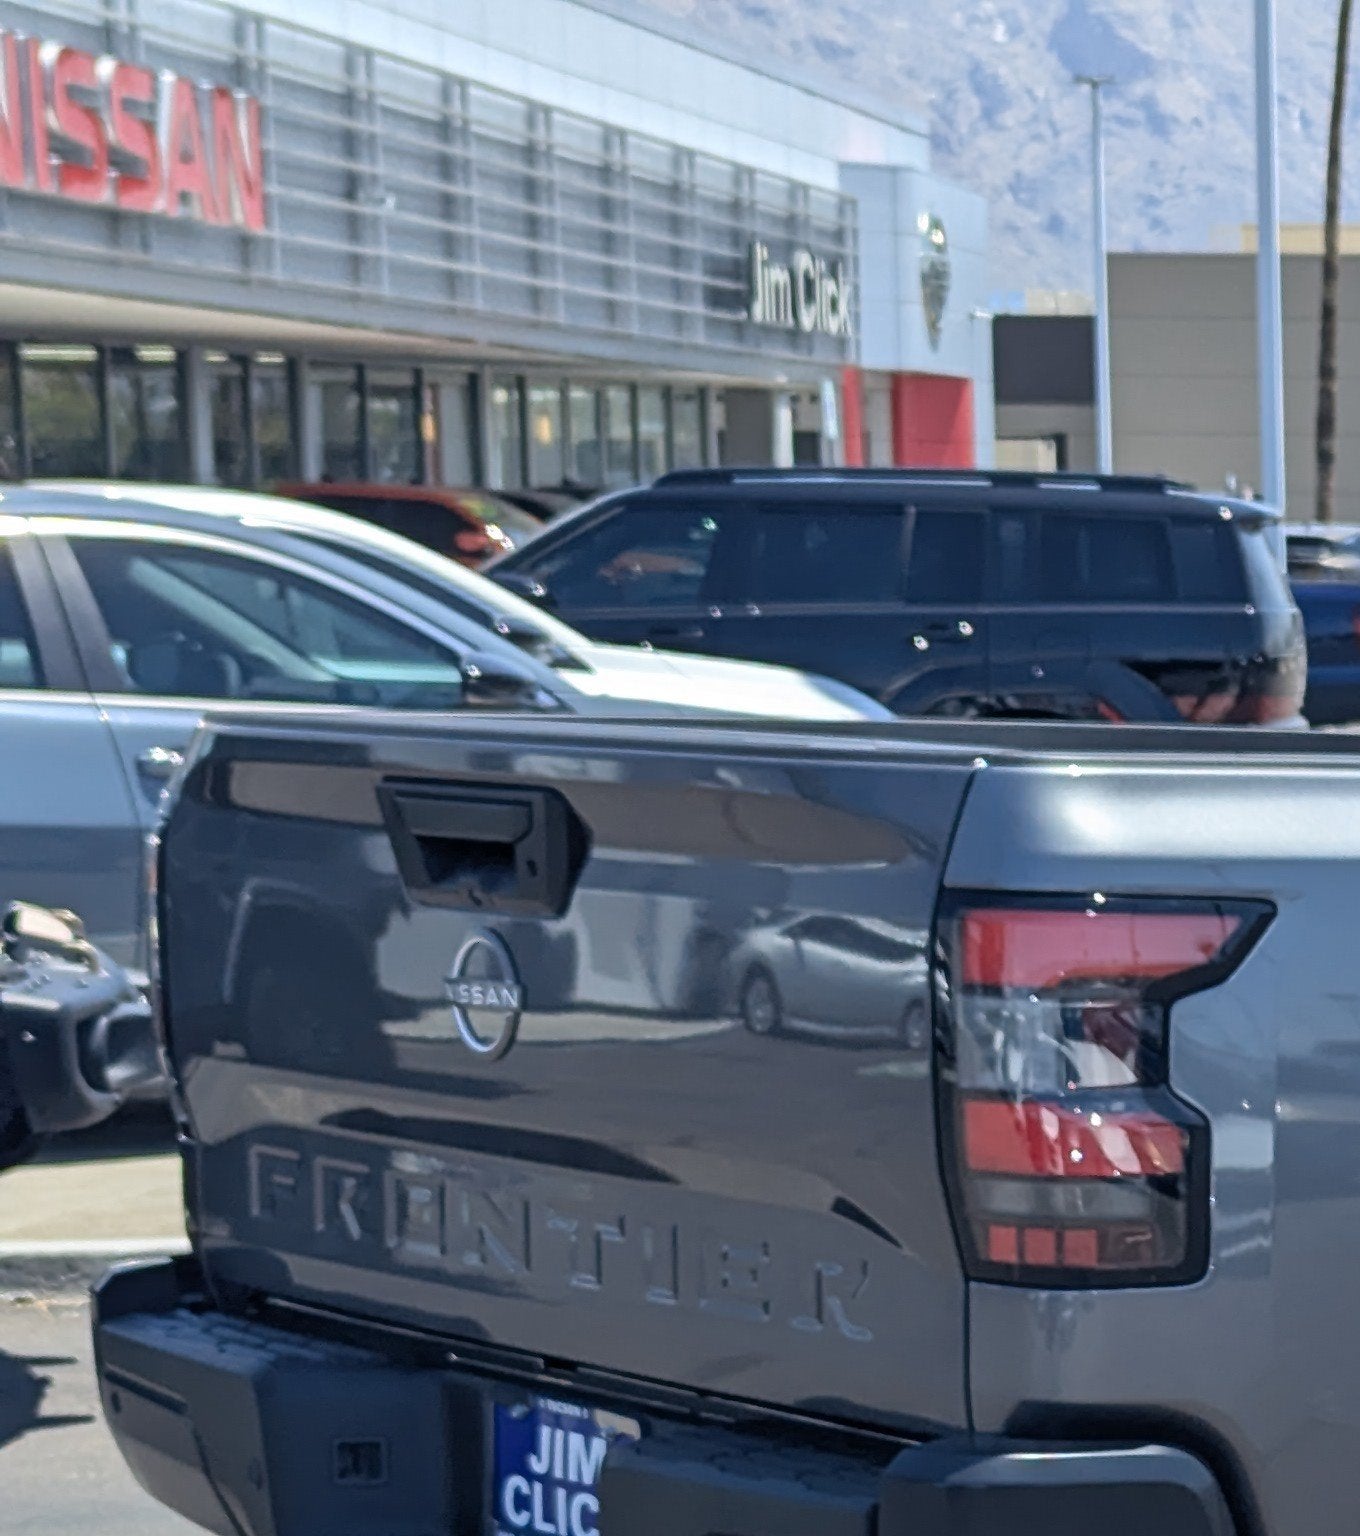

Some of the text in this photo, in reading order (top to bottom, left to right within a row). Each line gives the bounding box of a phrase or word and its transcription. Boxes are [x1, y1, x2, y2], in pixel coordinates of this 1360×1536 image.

[752, 241, 852, 337] Jim Click
[444, 982, 519, 1008] NSSAN
[246, 1143, 874, 1343] FRONTIER
[528, 1424, 607, 1485] JIM
